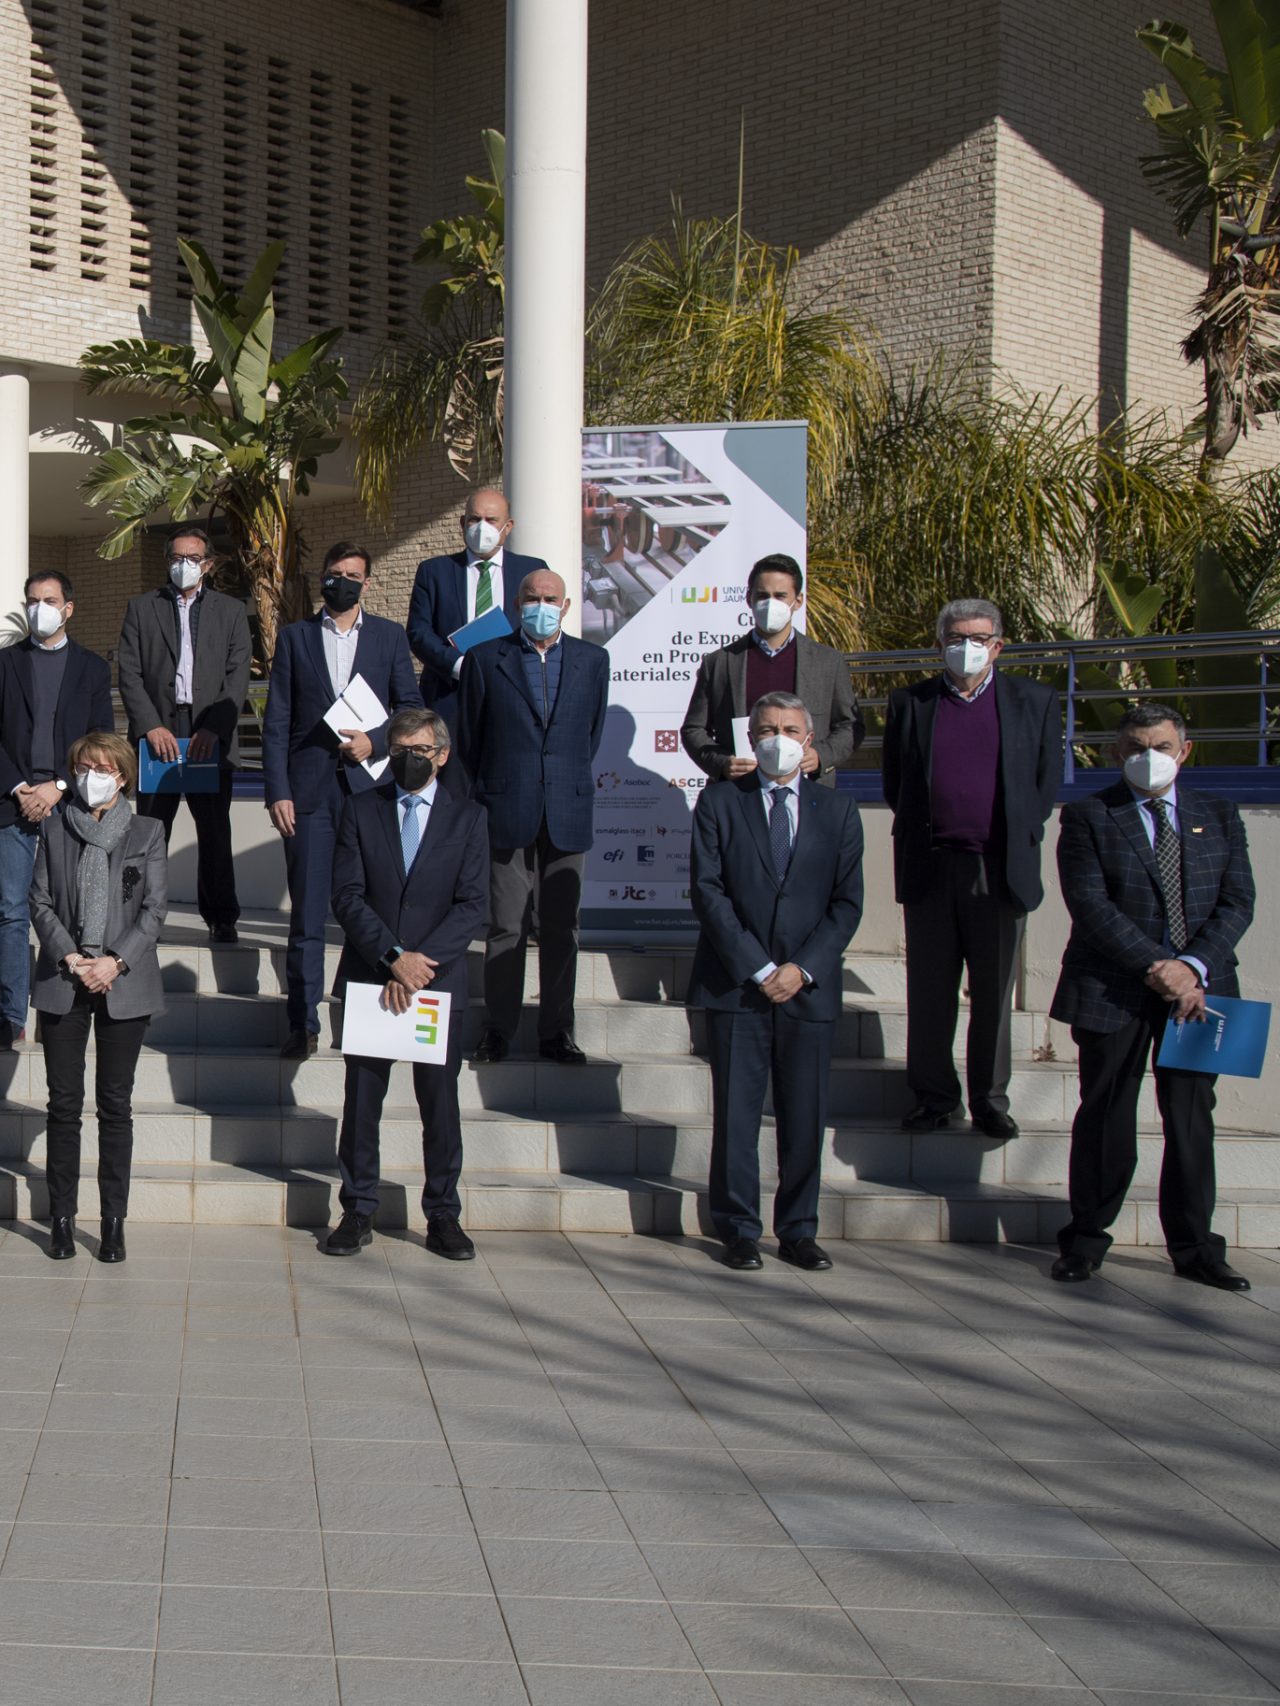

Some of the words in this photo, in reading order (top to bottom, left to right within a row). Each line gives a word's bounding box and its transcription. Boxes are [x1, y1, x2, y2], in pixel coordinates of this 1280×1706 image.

[681, 586, 718, 603] UJI
[671, 631, 693, 646] de
[698, 631, 743, 649] Expe
[643, 652, 664, 664] en
[608, 667, 691, 682] ateriales
[604, 849, 624, 862] efi
